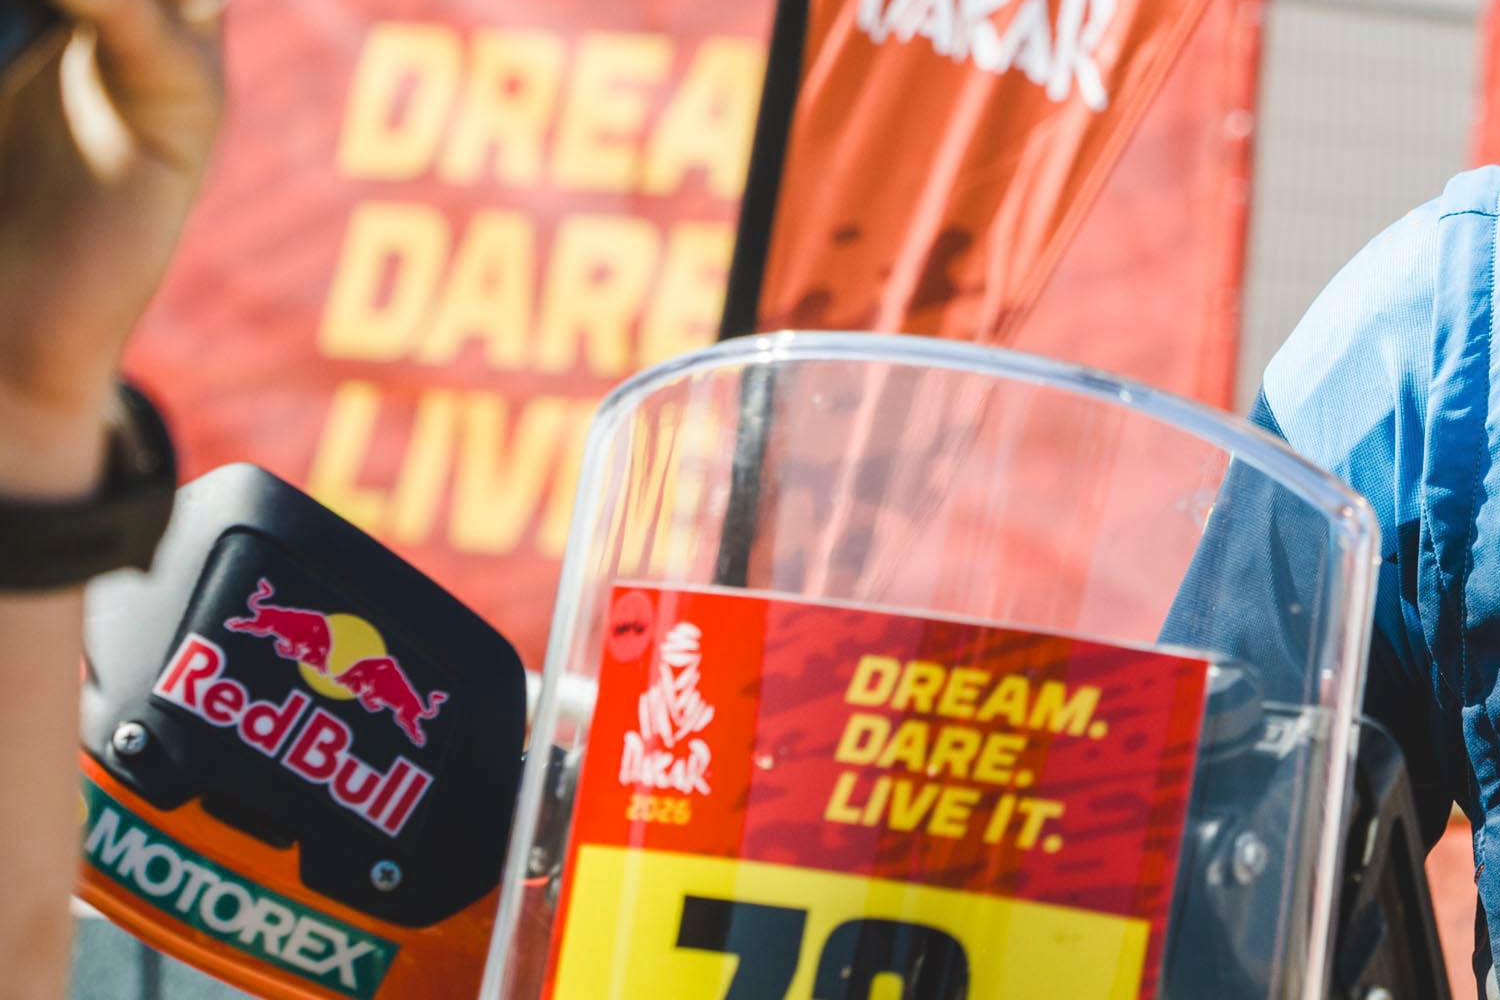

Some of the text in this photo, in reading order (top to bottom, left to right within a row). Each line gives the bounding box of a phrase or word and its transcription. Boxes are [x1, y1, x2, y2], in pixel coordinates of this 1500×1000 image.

[152, 632, 434, 838] Red Bull
[844, 654, 1109, 740] DREAM.
[618, 730, 712, 796] DAKAR
[833, 712, 1035, 789] DARE.
[823, 771, 1066, 854] LIVE IT.
[84, 806, 376, 991] MOTOREX
